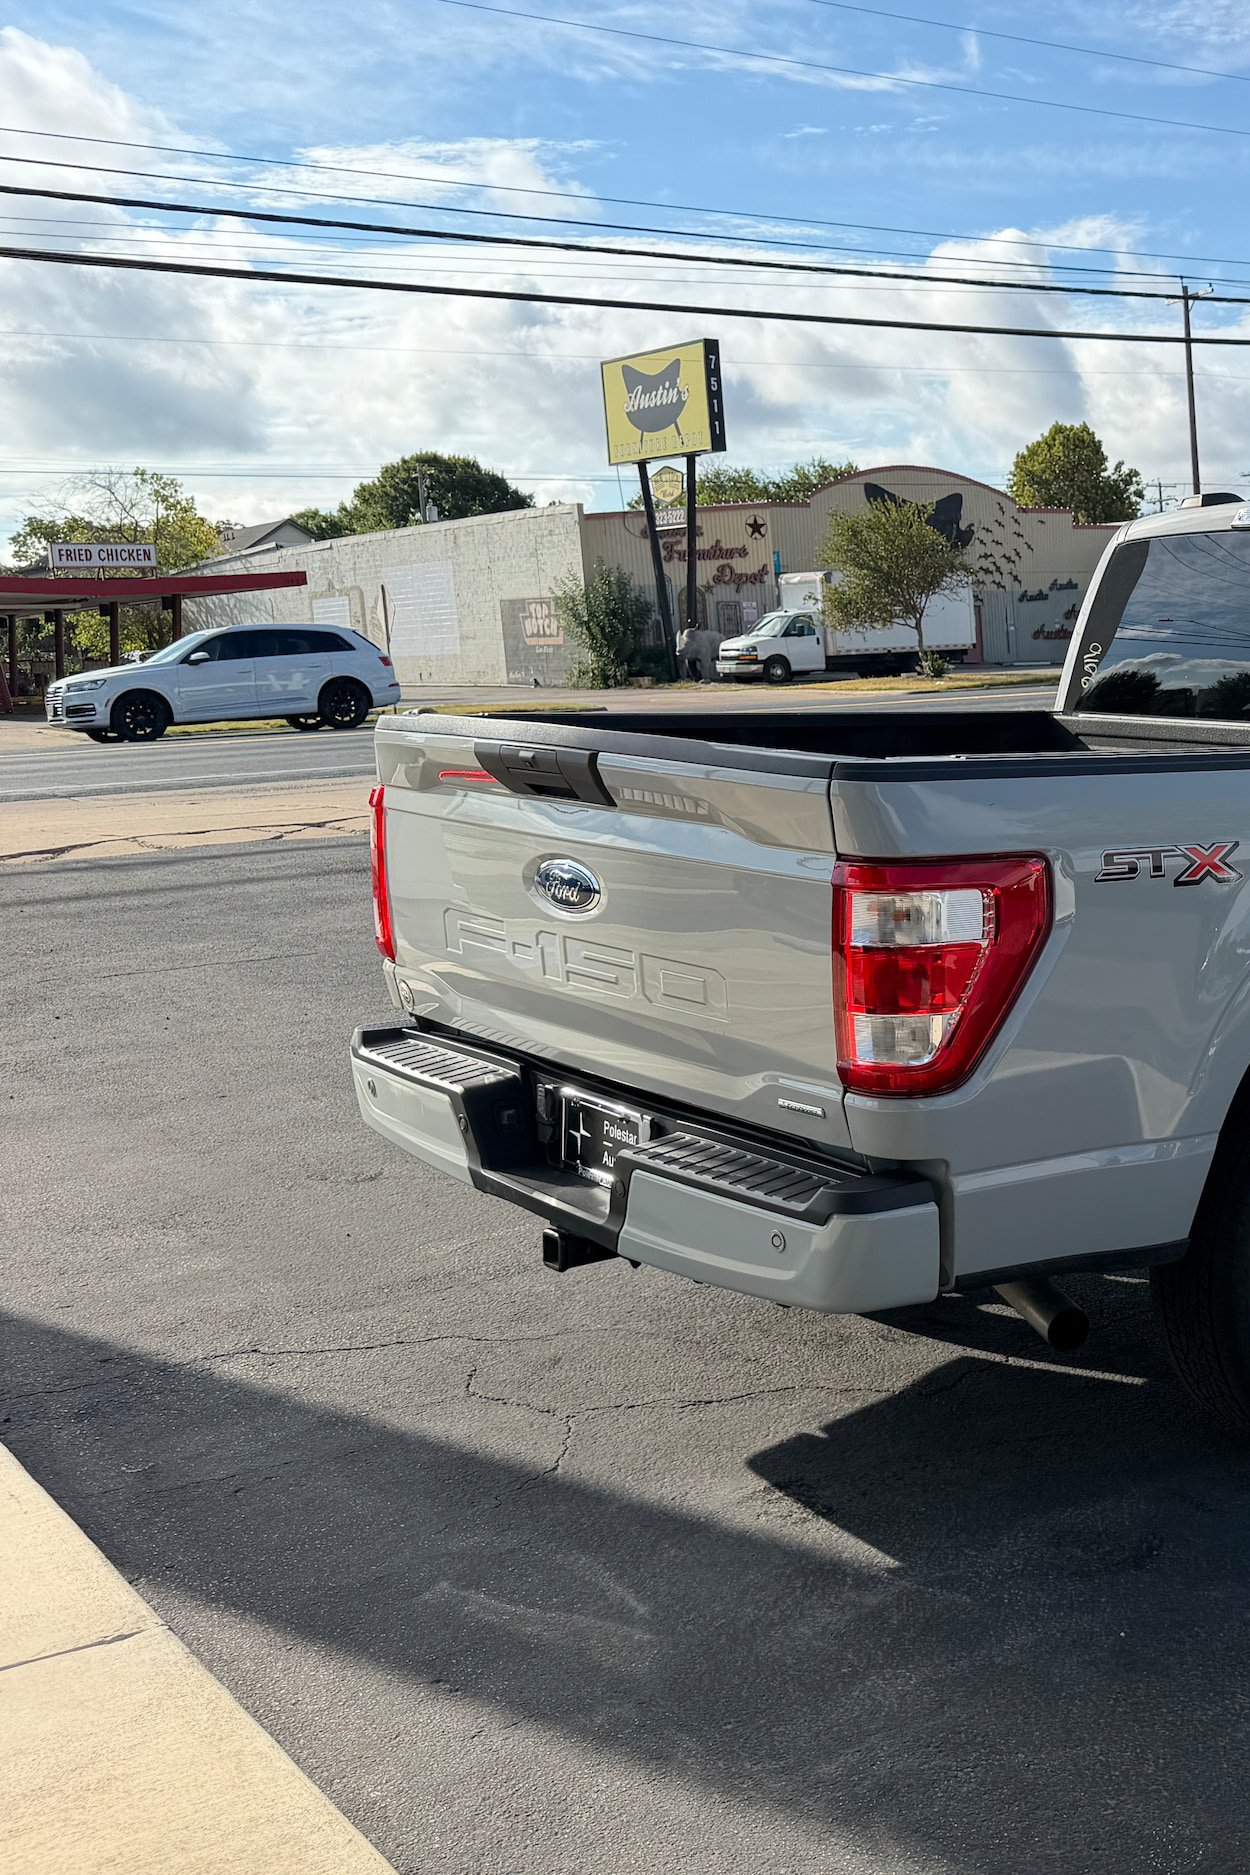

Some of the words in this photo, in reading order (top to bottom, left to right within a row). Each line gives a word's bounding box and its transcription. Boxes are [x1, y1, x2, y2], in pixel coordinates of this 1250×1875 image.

[624, 376, 690, 413] Austin's
[708, 354, 721, 435] 7511
[615, 436, 668, 458] FURNITURE
[673, 430, 704, 449] DEPOT
[58, 548, 92, 562] FRIED
[97, 548, 151, 562] CHICKEN
[662, 539, 749, 563] Funiture
[713, 563, 770, 593] Depot
[528, 602, 549, 620] TOP
[524, 617, 558, 637] NOTCH
[1095, 841, 1244, 887] STX
[545, 867, 581, 902] Ford
[443, 908, 731, 1024] F-150
[603, 1120, 638, 1146] Polestar
